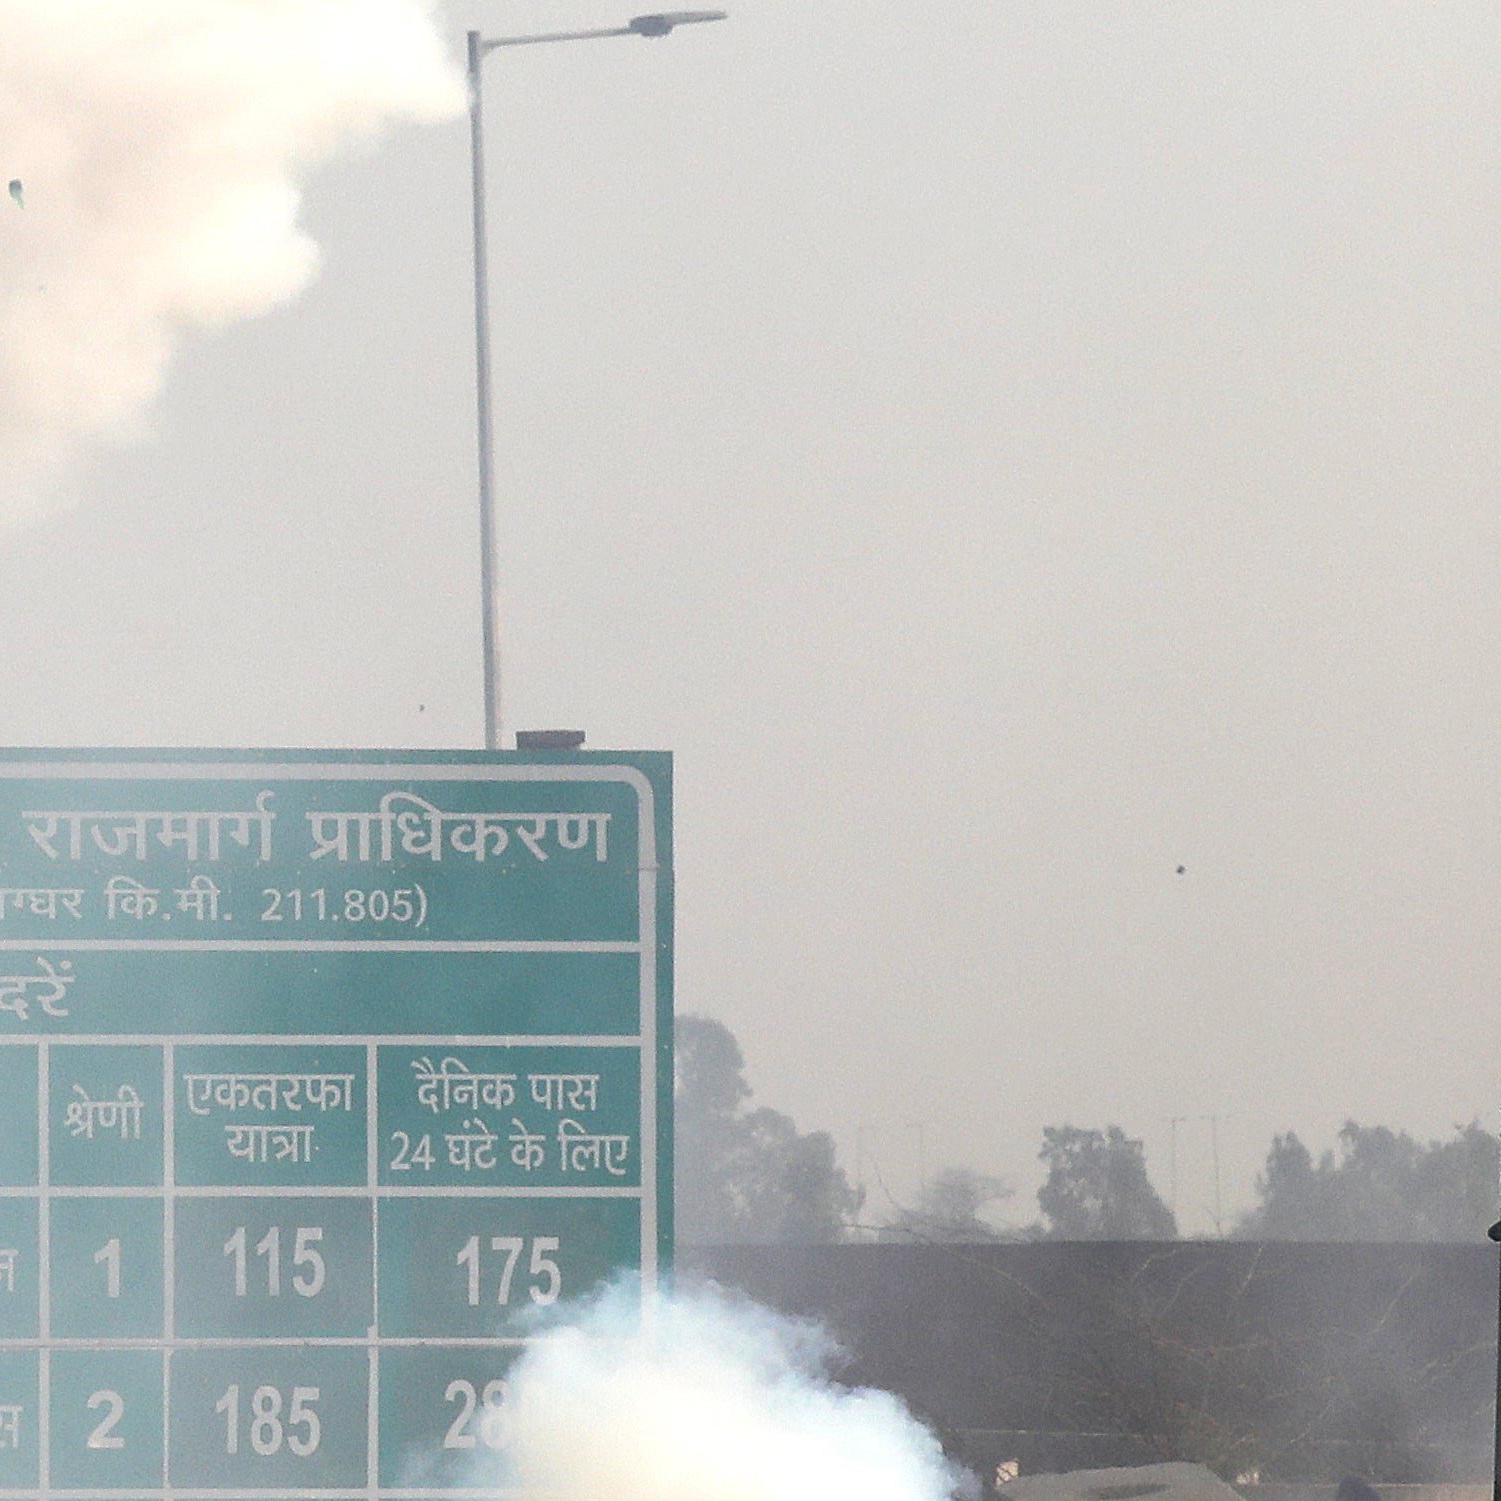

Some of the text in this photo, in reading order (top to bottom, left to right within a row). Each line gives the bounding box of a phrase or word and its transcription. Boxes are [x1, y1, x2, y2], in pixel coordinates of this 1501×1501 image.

[23, 790, 276, 862] राजमार्ग
[305, 791, 610, 863] प्राधिकरण
[262, 885, 428, 926] 211.805)
[64, 1084, 144, 1140] श्रेणी
[182, 1073, 355, 1114] एकतरफा
[411, 1056, 600, 1115] दैनिक पास
[226, 1124, 315, 1163] यात्रा
[390, 1118, 629, 1175] 24 घंटे के लिए
[93, 1239, 123, 1298] 1
[223, 1226, 327, 1298] 115
[456, 1236, 563, 1305] 175
[86, 1390, 126, 1450] 2
[216, 1386, 322, 1455] 185
